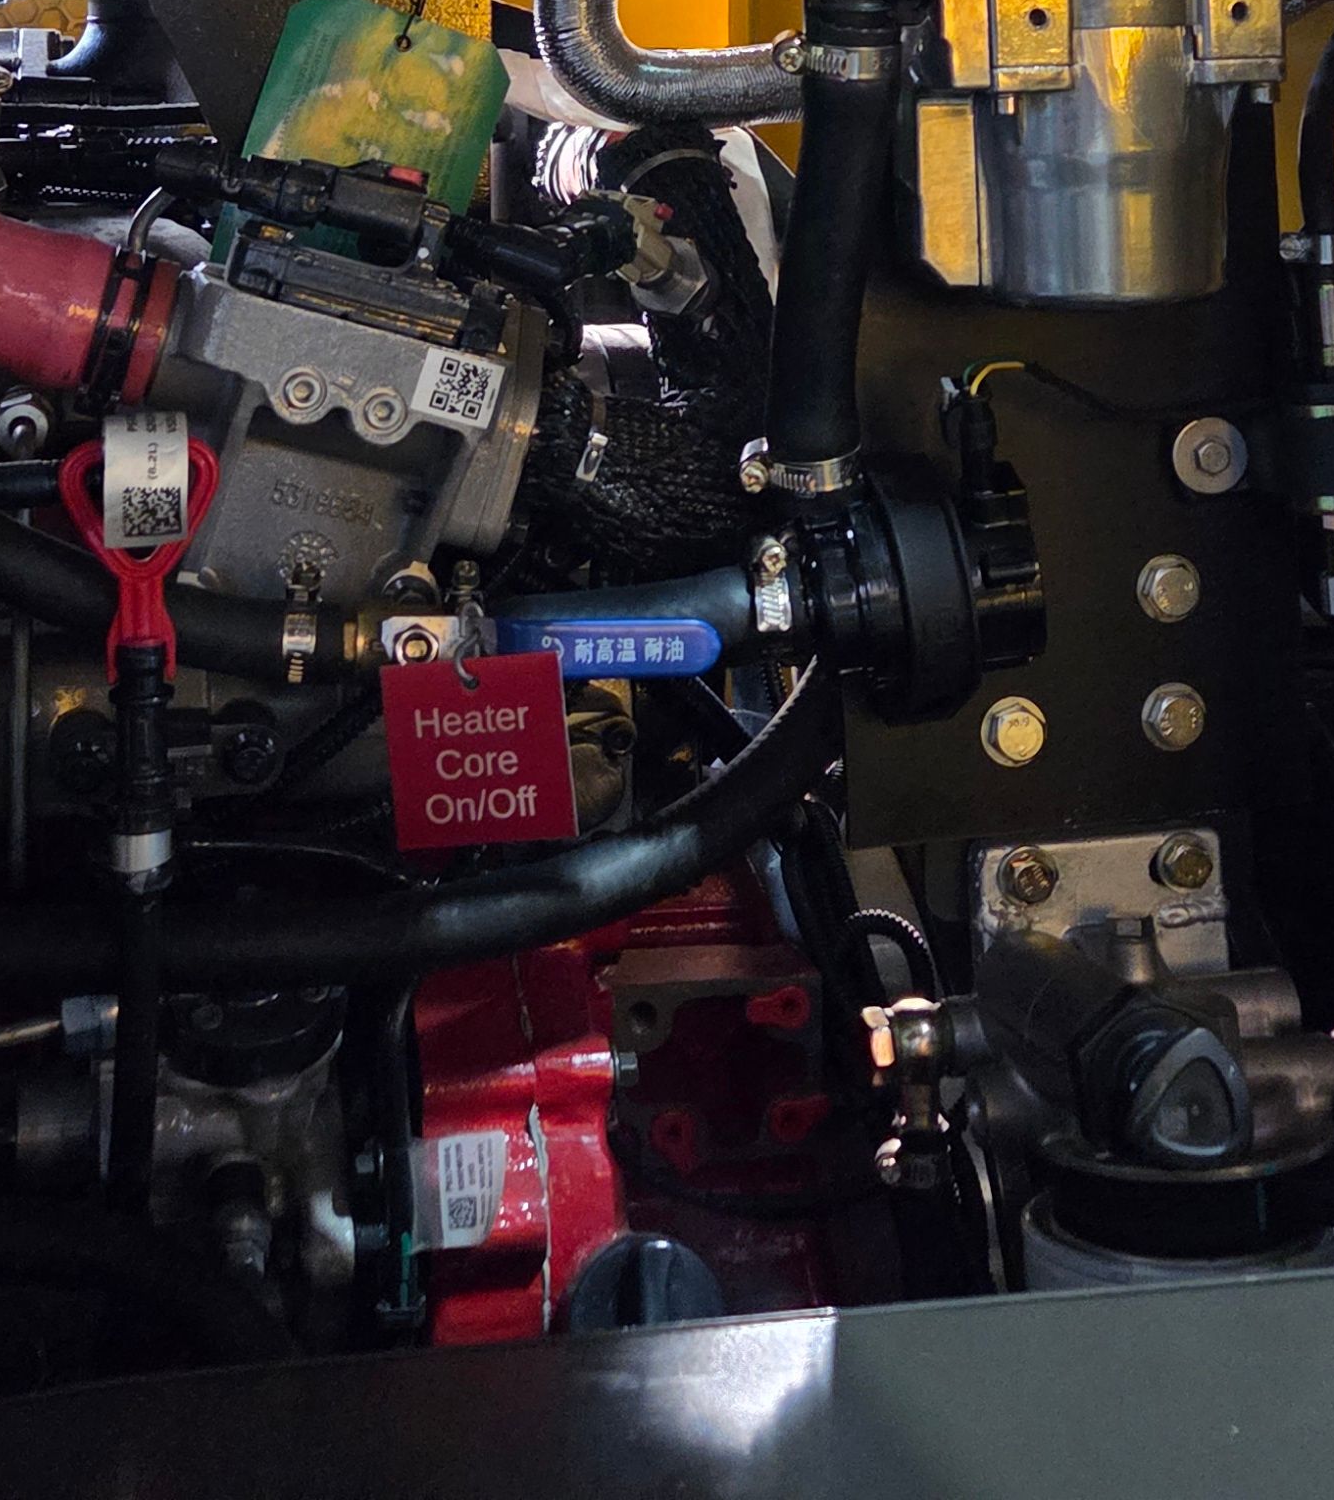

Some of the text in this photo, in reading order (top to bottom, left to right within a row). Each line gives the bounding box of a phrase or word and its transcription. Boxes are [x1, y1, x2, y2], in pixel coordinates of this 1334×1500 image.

[574, 635, 685, 664] 耐高温 耐油
[414, 706, 529, 738] Heater
[436, 749, 519, 781] Core
[425, 785, 538, 825] On/Off
